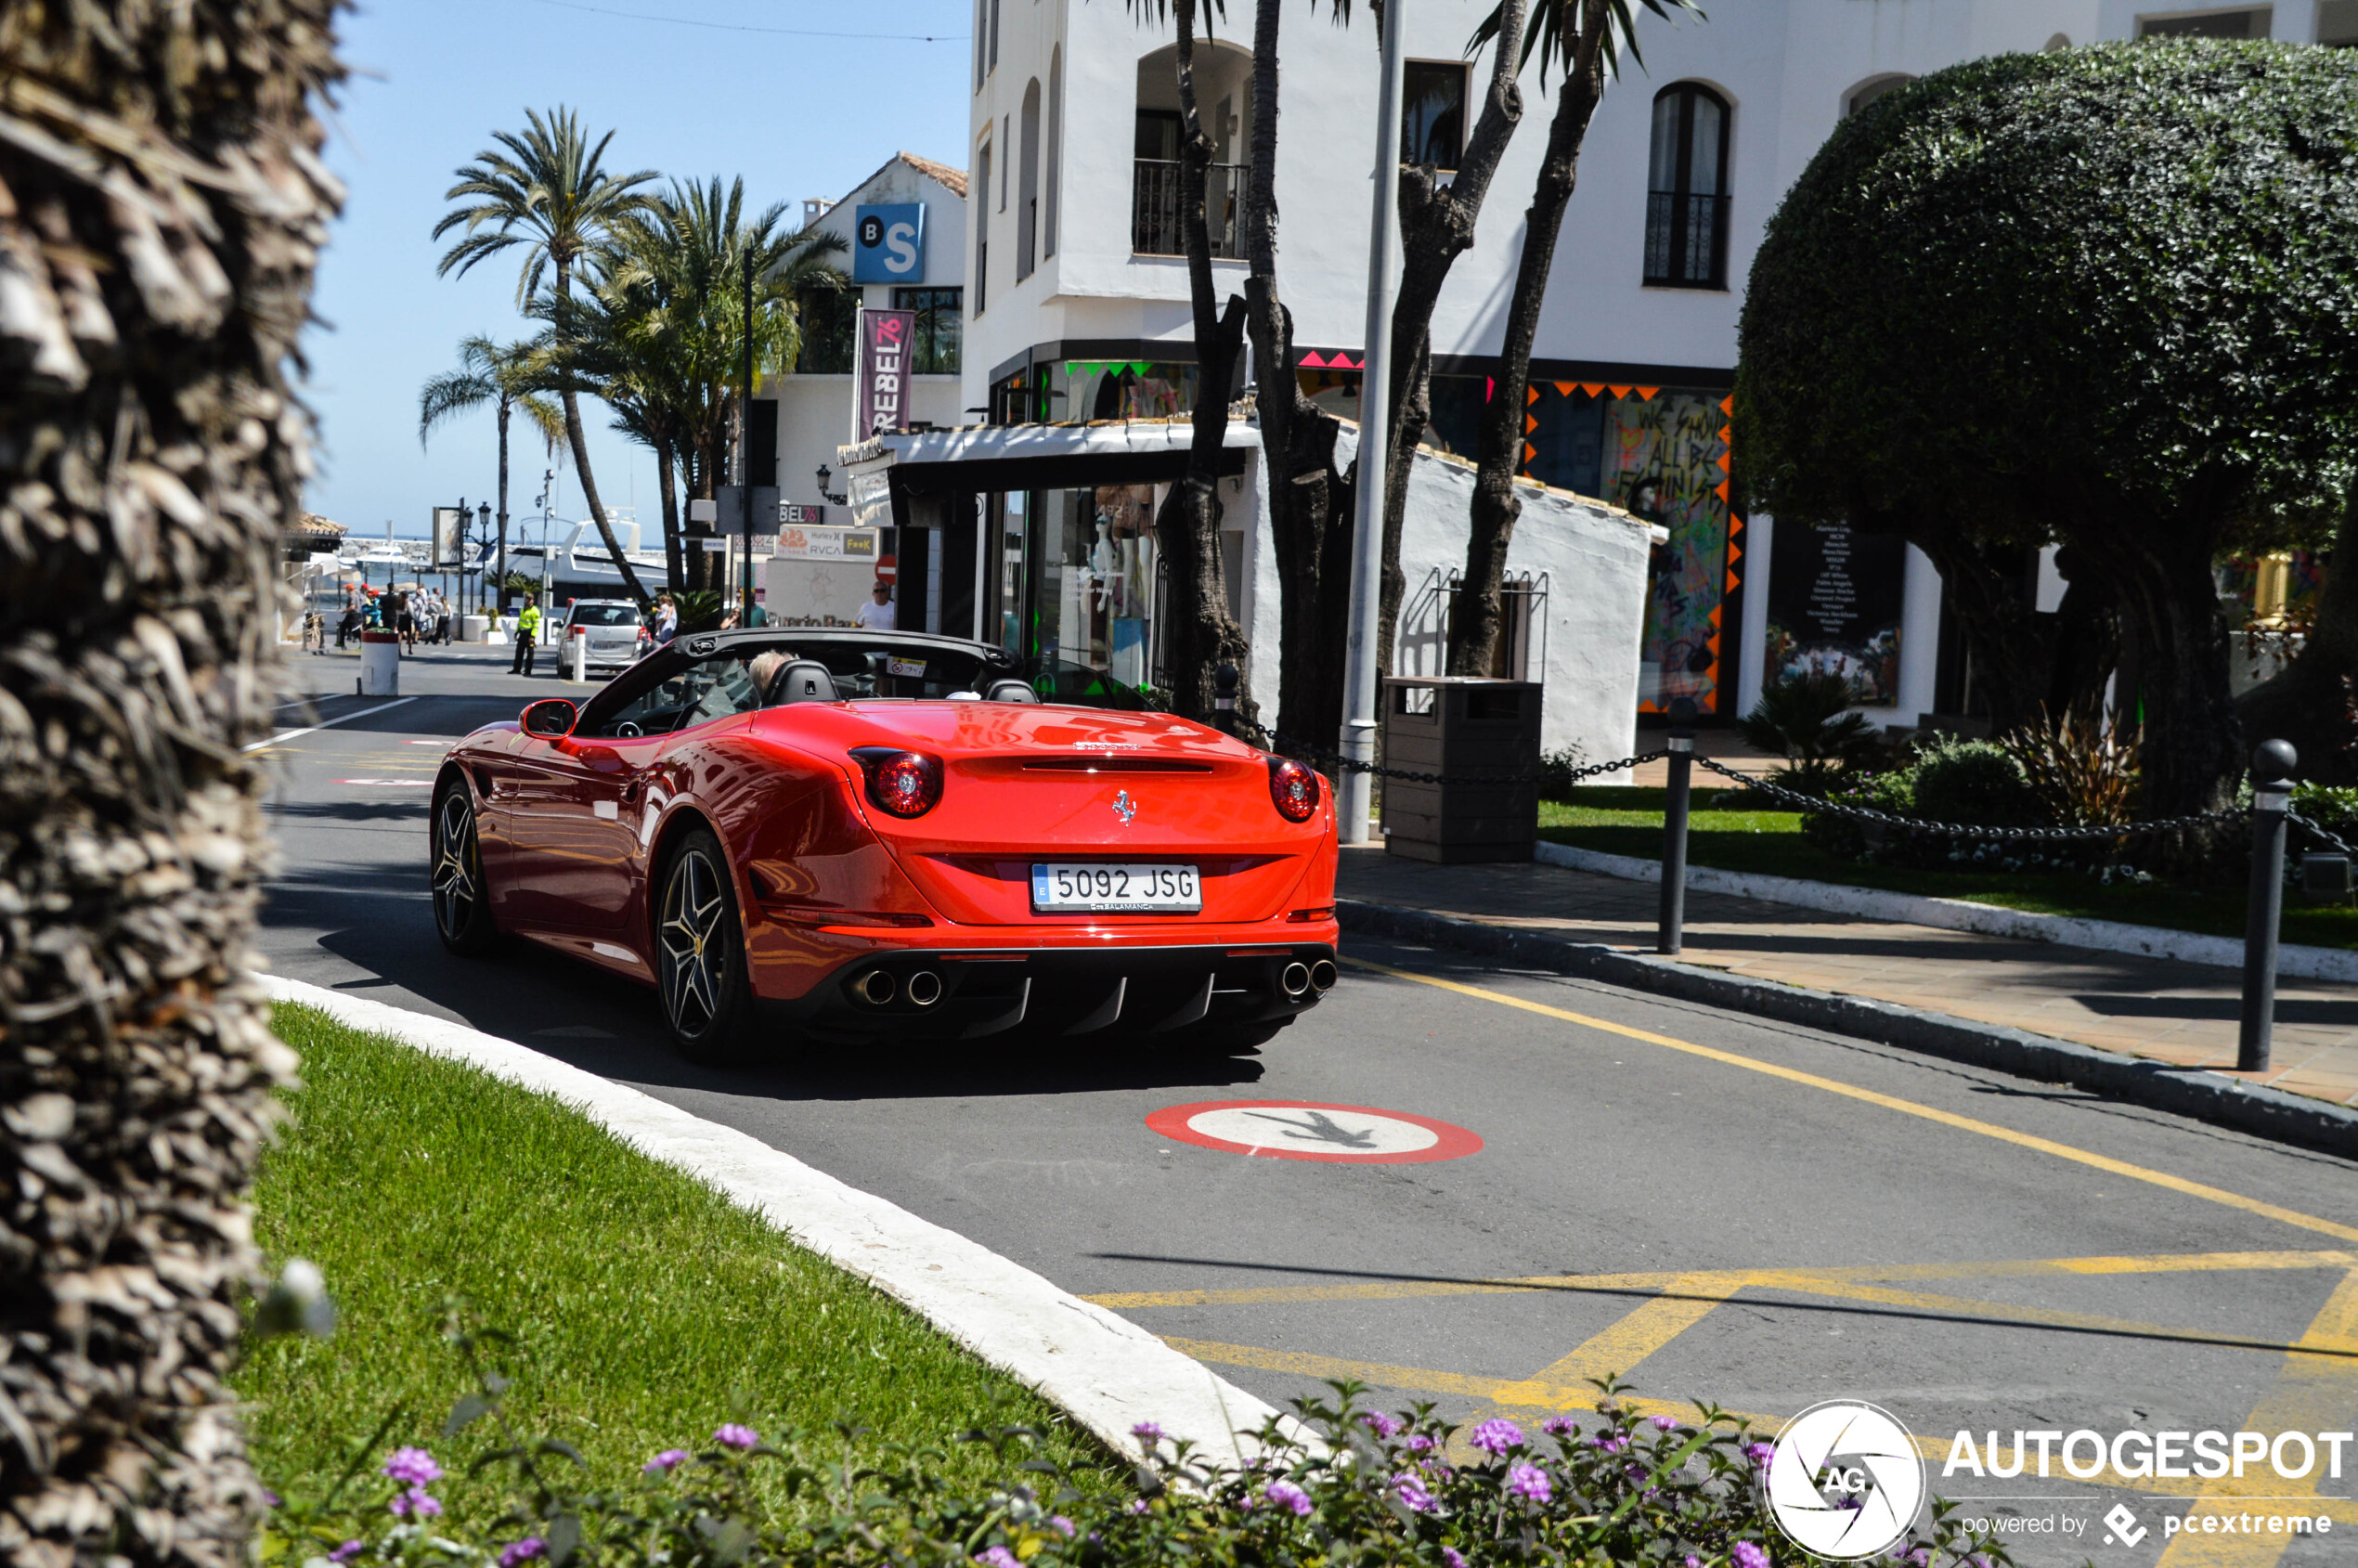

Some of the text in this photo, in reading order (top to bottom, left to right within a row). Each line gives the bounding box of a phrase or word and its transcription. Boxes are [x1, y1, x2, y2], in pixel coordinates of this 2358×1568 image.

[865, 221, 917, 274] B S
[872, 317, 901, 430] REBEL76
[1638, 405, 1666, 435] WE
[1650, 437, 1717, 476] ALL BE
[810, 545, 841, 555] RVCA
[811, 532, 833, 540] Hurley
[1039, 869, 1193, 899] E 5092 JSG
